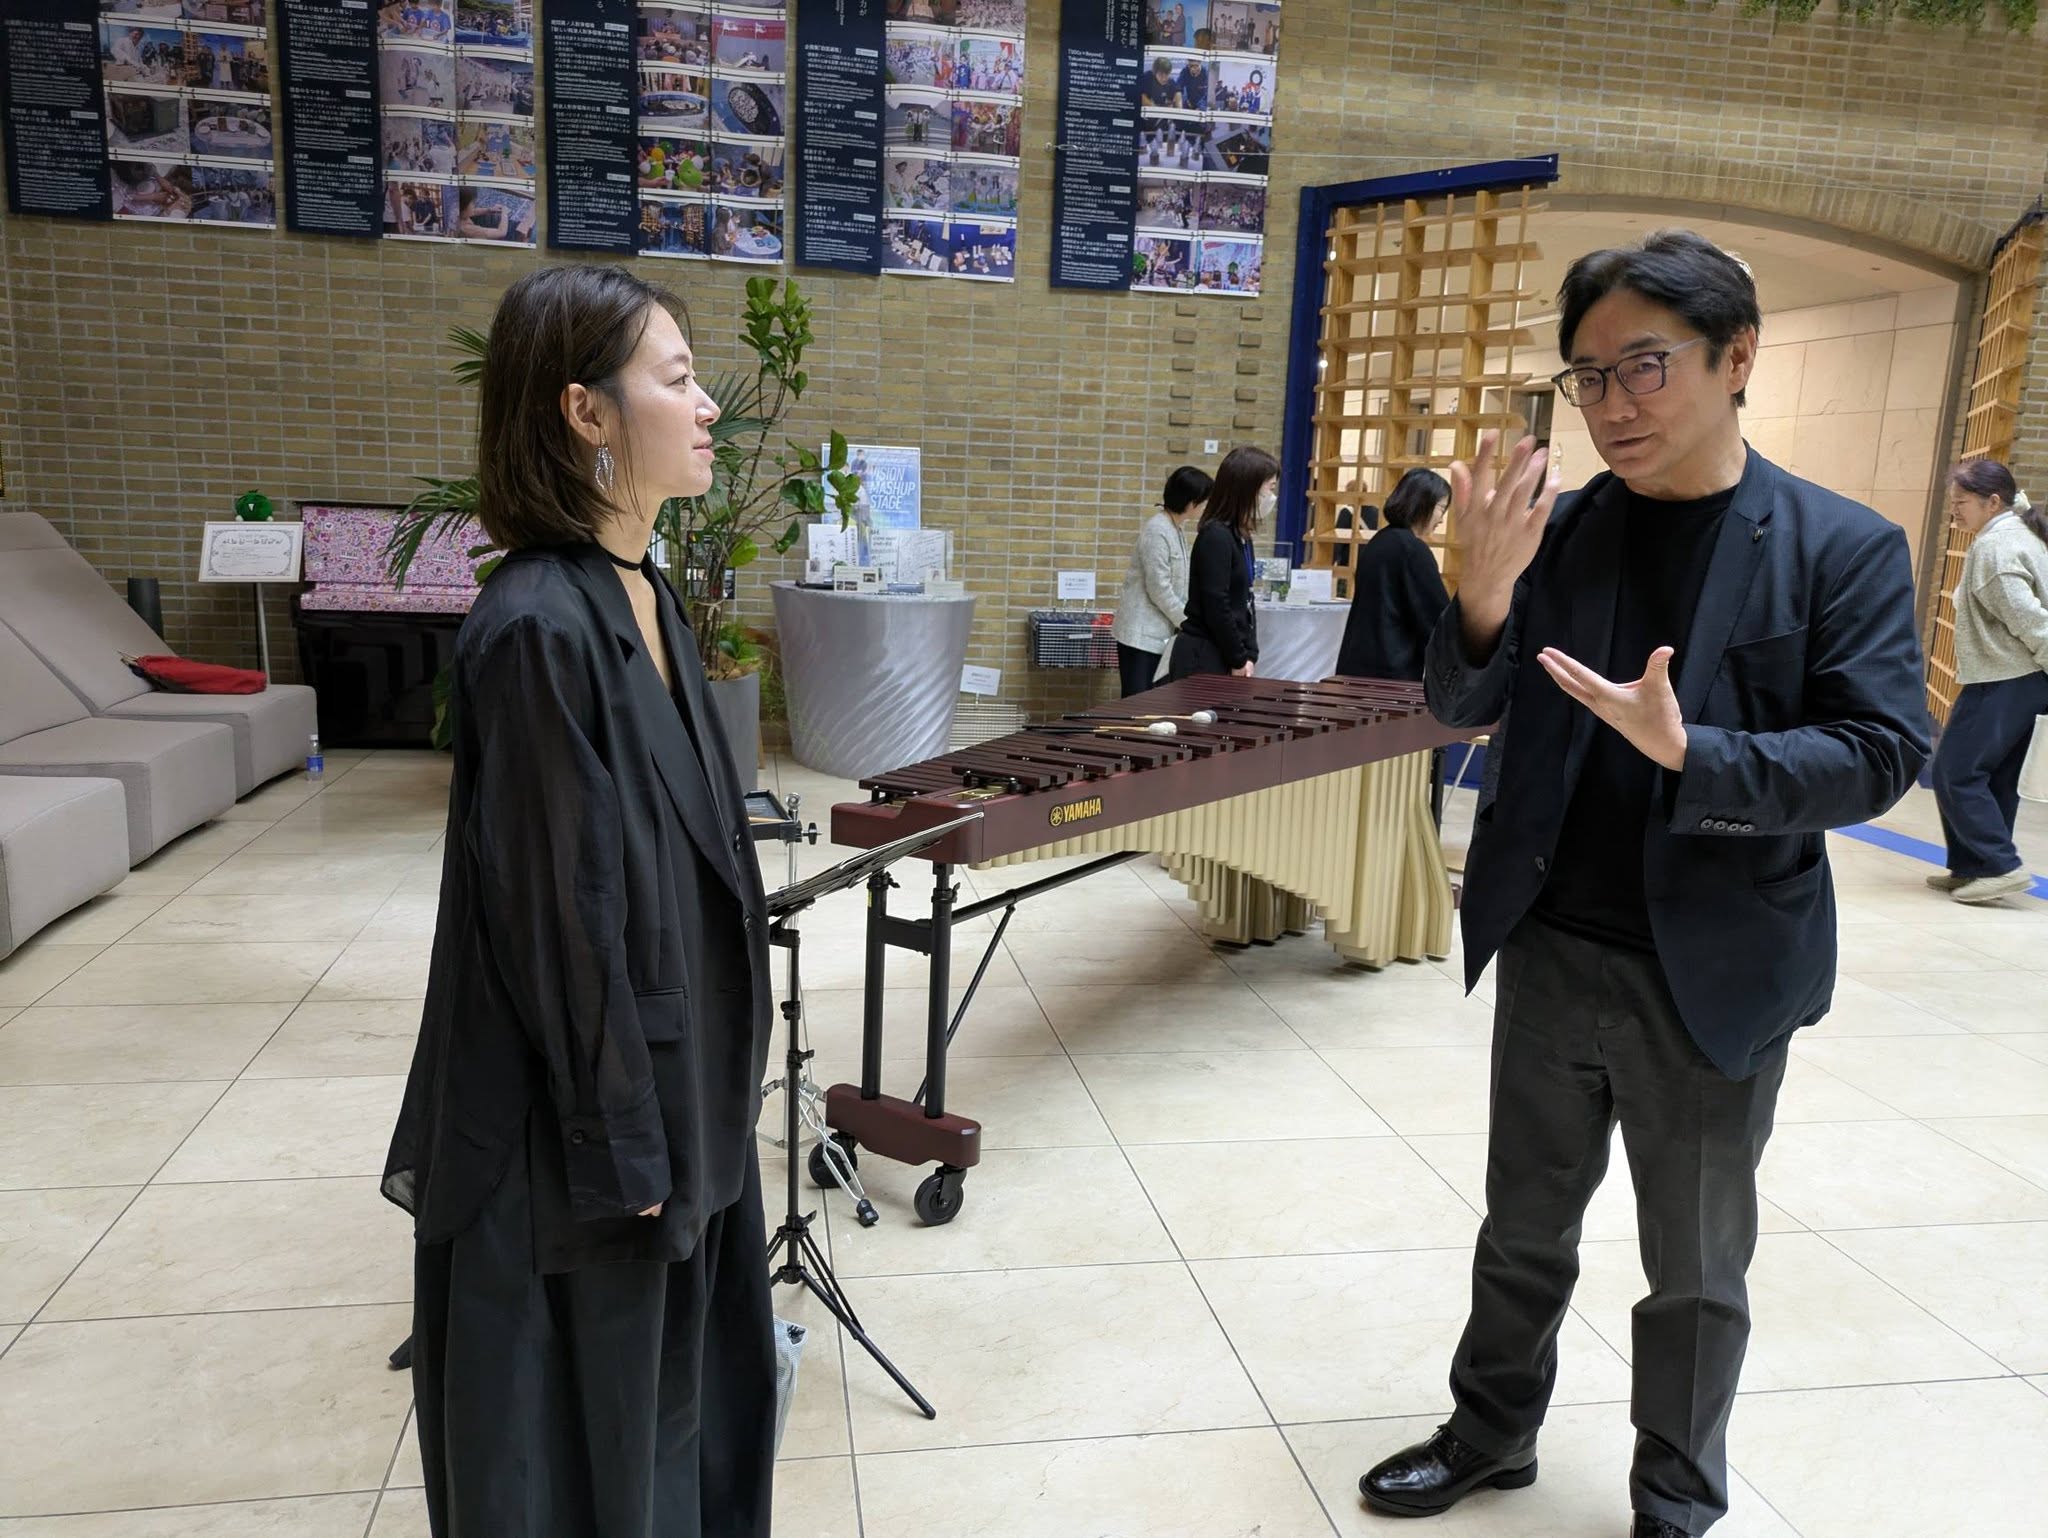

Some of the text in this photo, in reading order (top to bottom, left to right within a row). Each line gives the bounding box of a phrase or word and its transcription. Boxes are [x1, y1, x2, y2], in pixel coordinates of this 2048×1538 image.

[871, 467, 906, 481] VISION
[870, 481, 916, 496] MASHUP
[870, 494, 903, 510] STAGE
[1064, 797, 1102, 823] YAMAHA
